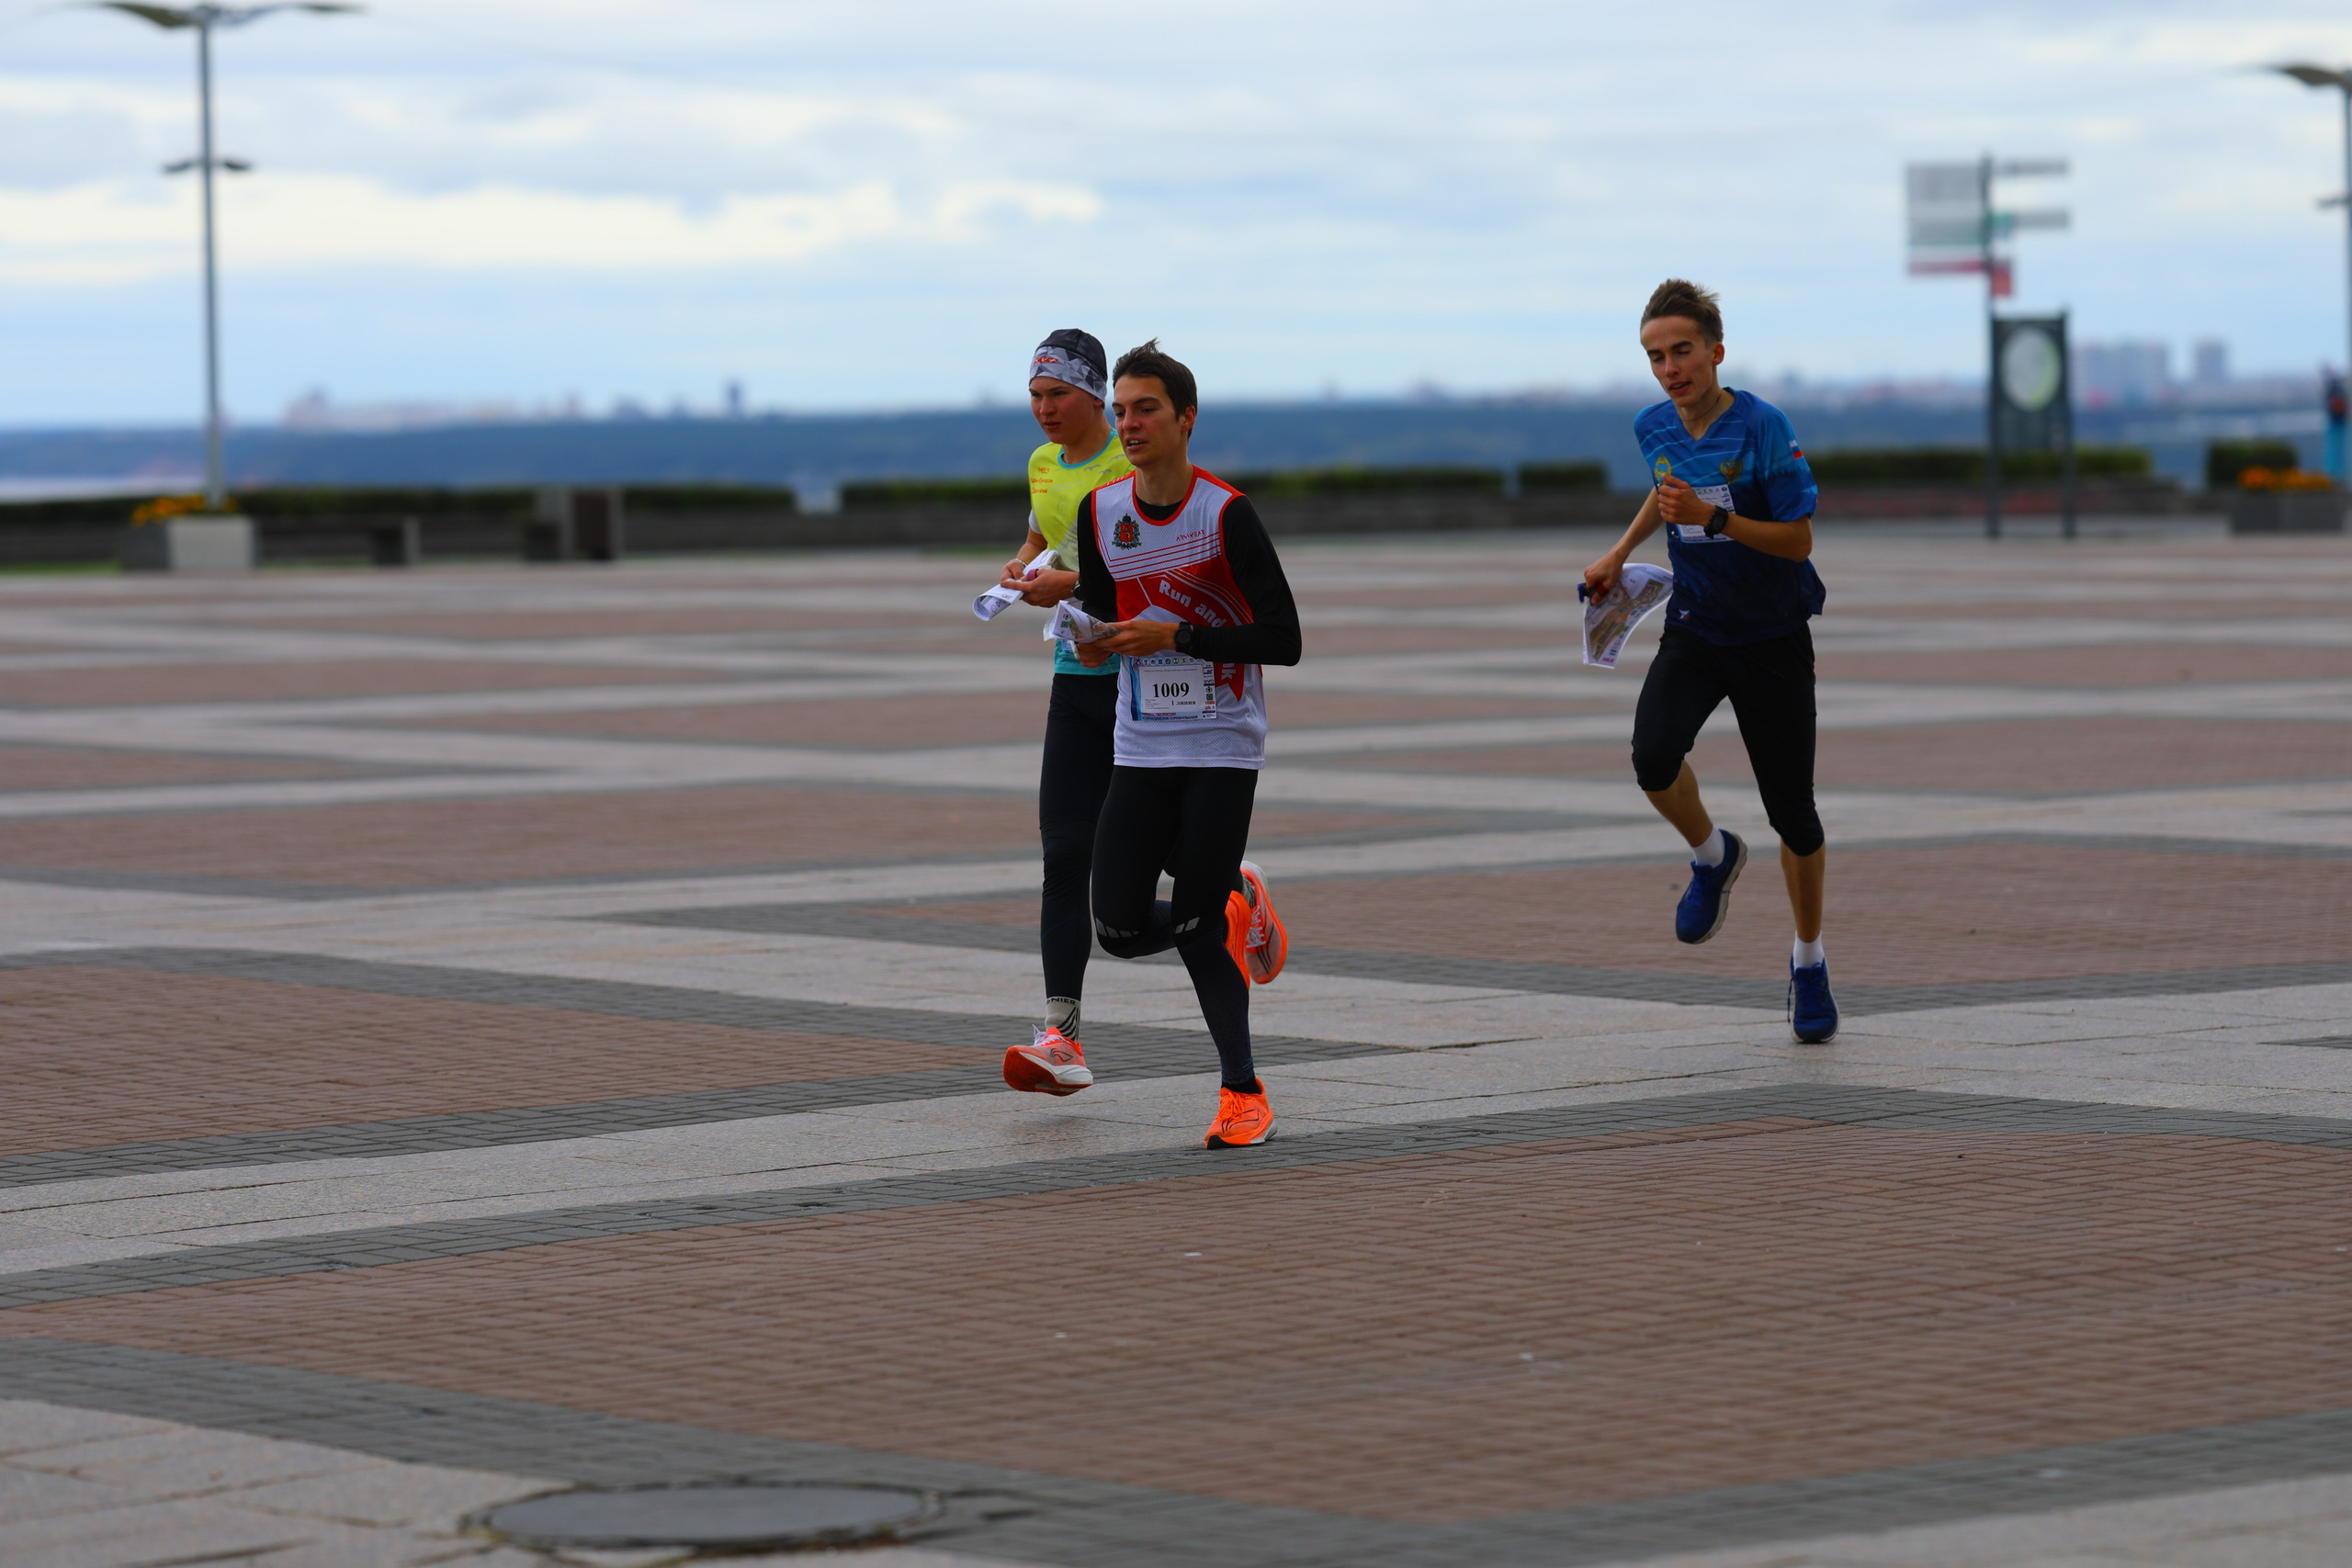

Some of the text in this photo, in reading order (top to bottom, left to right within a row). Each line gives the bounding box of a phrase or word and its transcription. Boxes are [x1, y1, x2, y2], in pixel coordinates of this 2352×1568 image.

[1159, 580, 1227, 627] Run and
[1153, 682, 1190, 698] 1009
